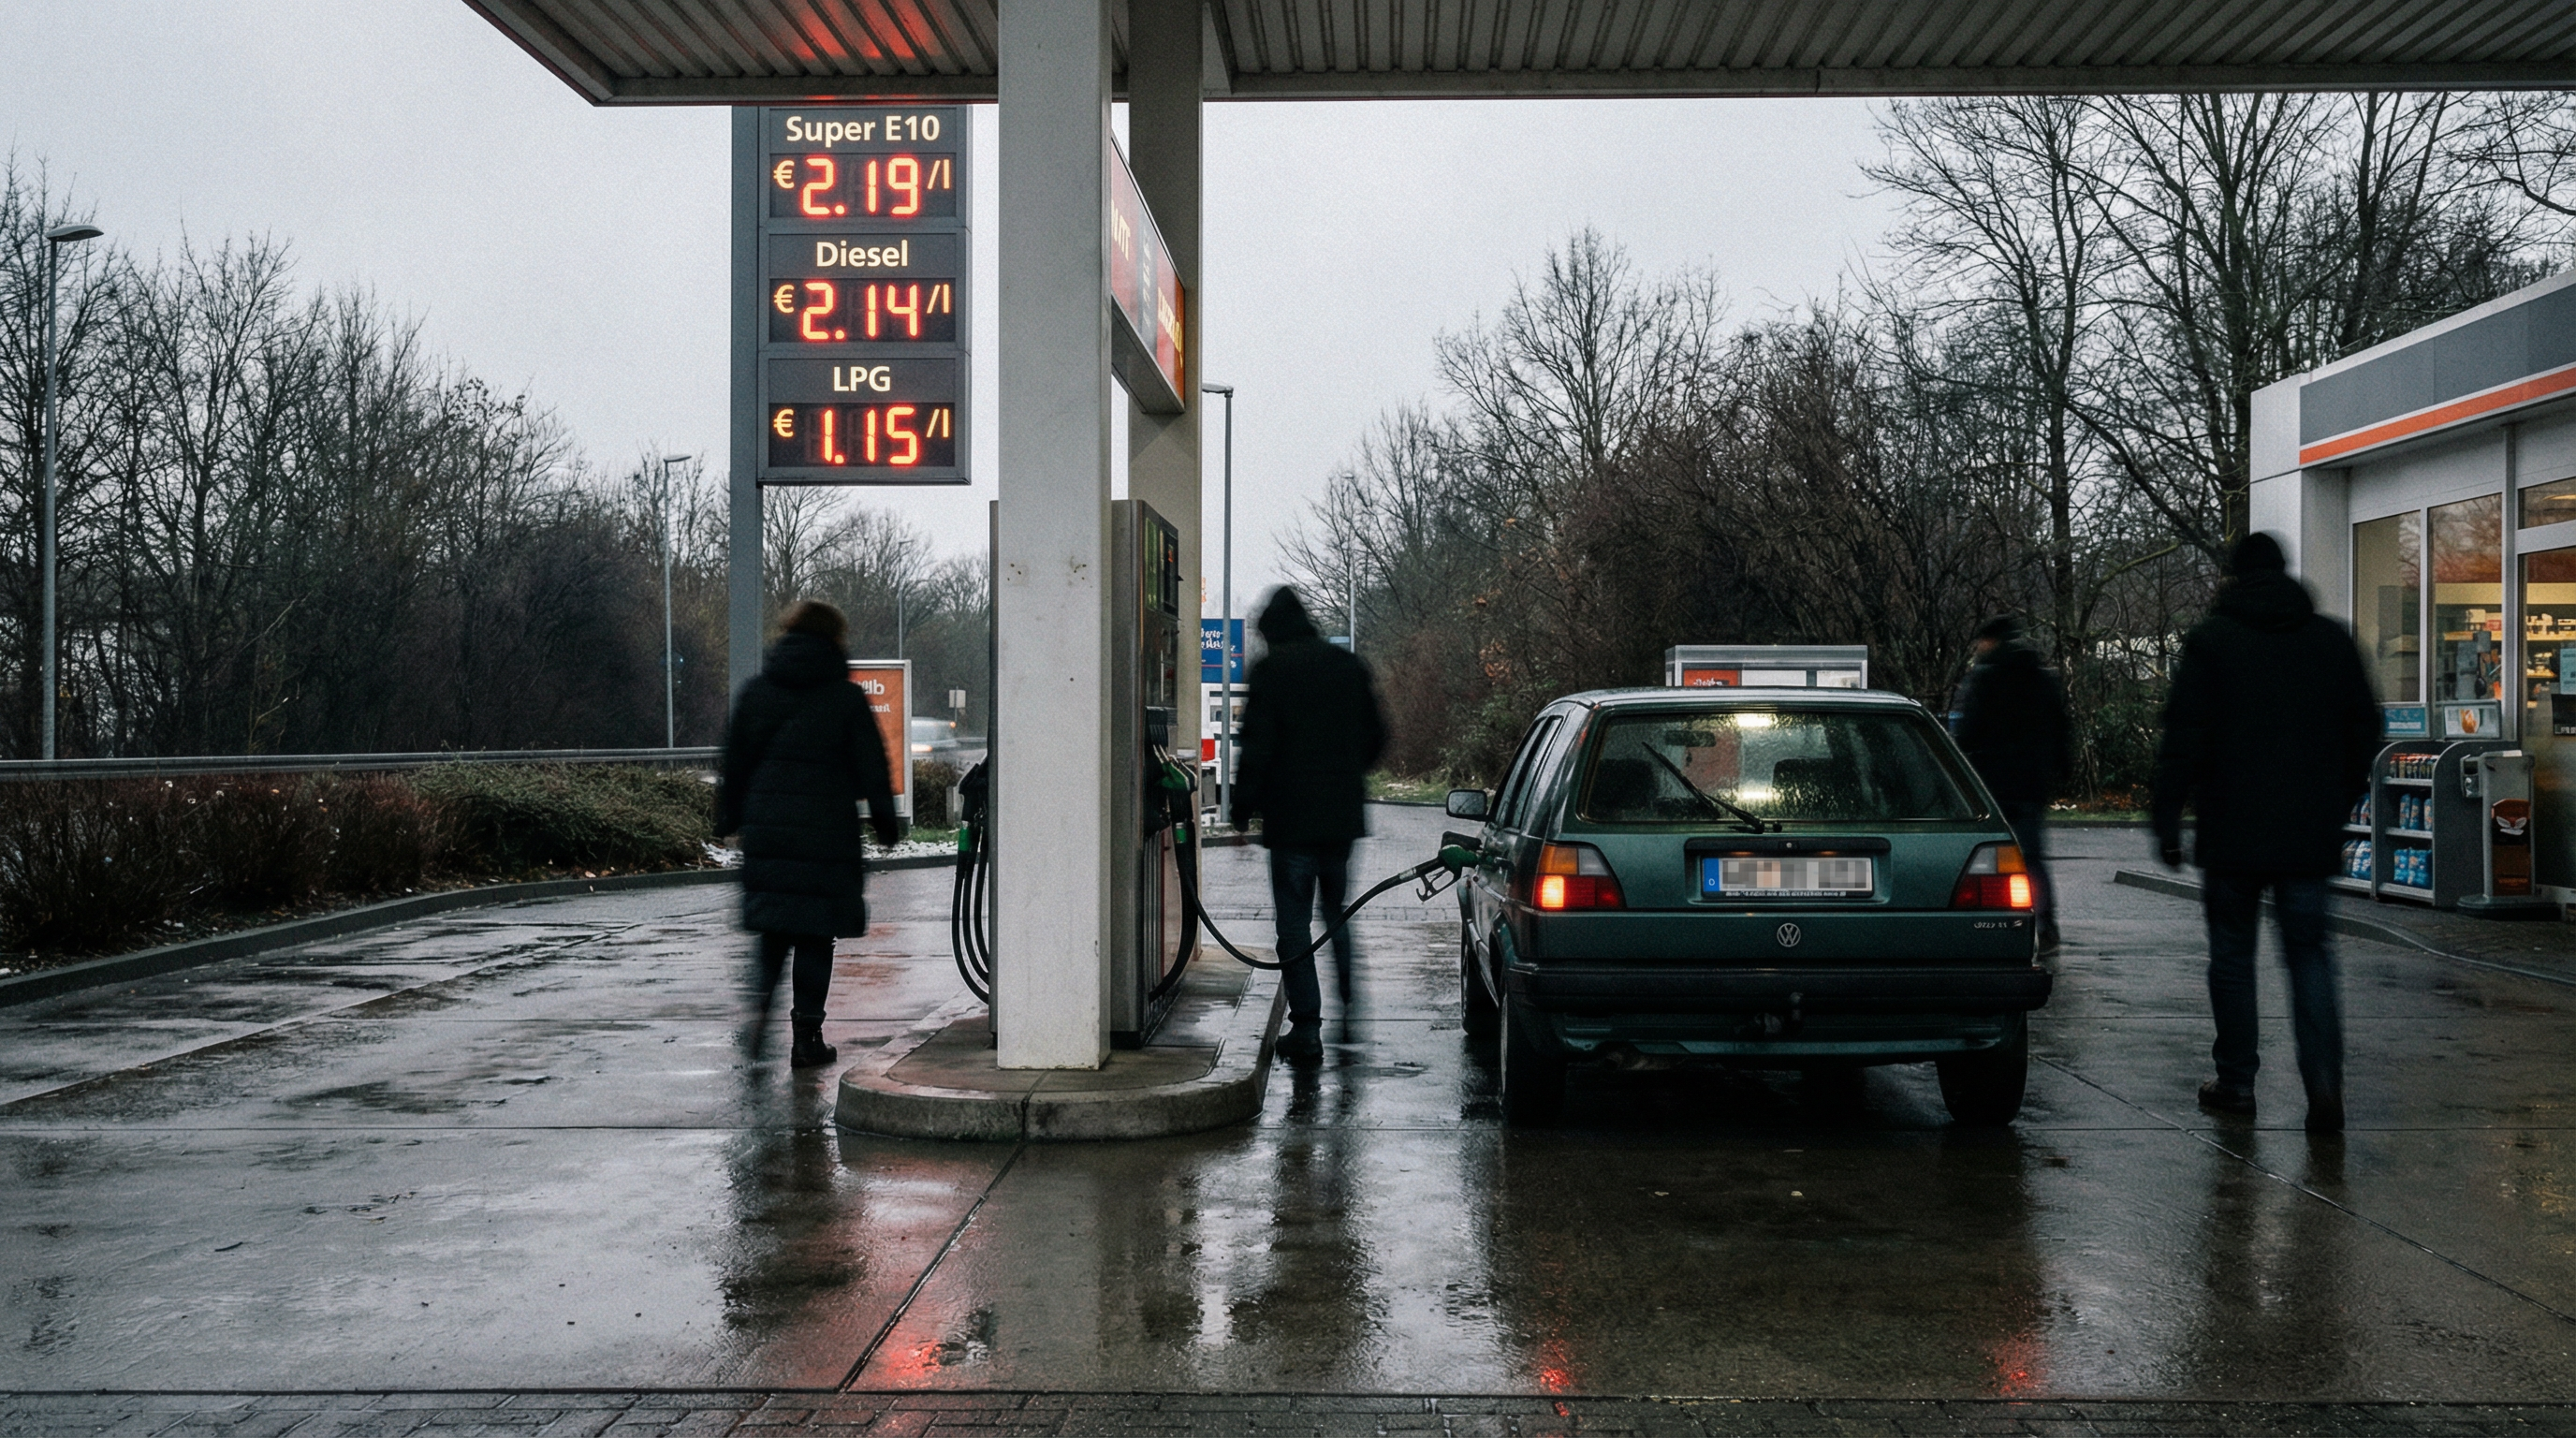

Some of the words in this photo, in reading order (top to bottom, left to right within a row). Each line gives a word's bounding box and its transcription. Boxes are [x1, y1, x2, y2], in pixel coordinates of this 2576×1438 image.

[786, 115, 875, 147] Super
[886, 115, 940, 141] E10
[773, 160, 795, 189] €
[802, 157, 918, 215] 2.19
[816, 240, 908, 267] Diesel
[773, 284, 794, 314] €
[802, 283, 918, 340] 2.14
[833, 366, 891, 392] LPG
[773, 408, 794, 438] €
[824, 406, 917, 464] 1.15
